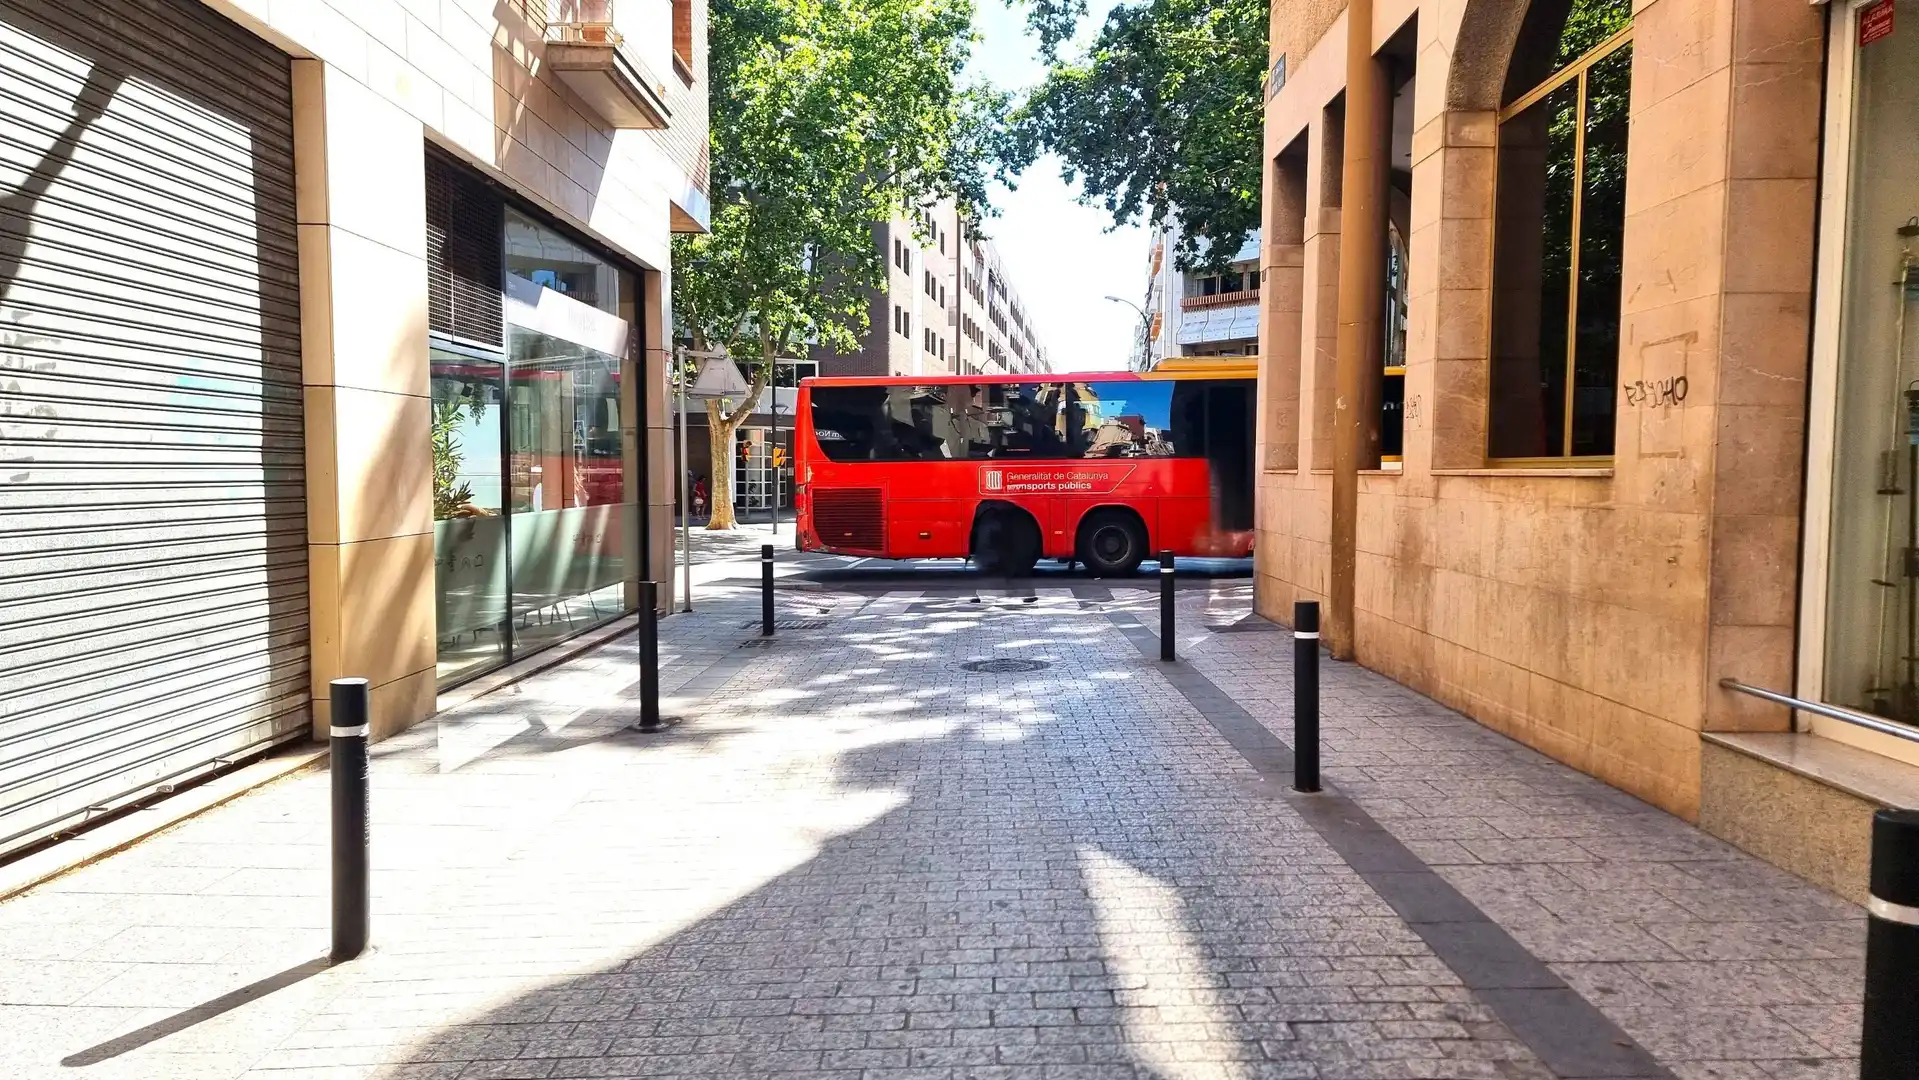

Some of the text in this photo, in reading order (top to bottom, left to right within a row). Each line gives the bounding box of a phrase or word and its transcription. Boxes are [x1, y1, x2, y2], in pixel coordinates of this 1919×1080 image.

[1006, 471, 1109, 481] Generalitat de Catalunya
[1058, 481, 1092, 491] públics
